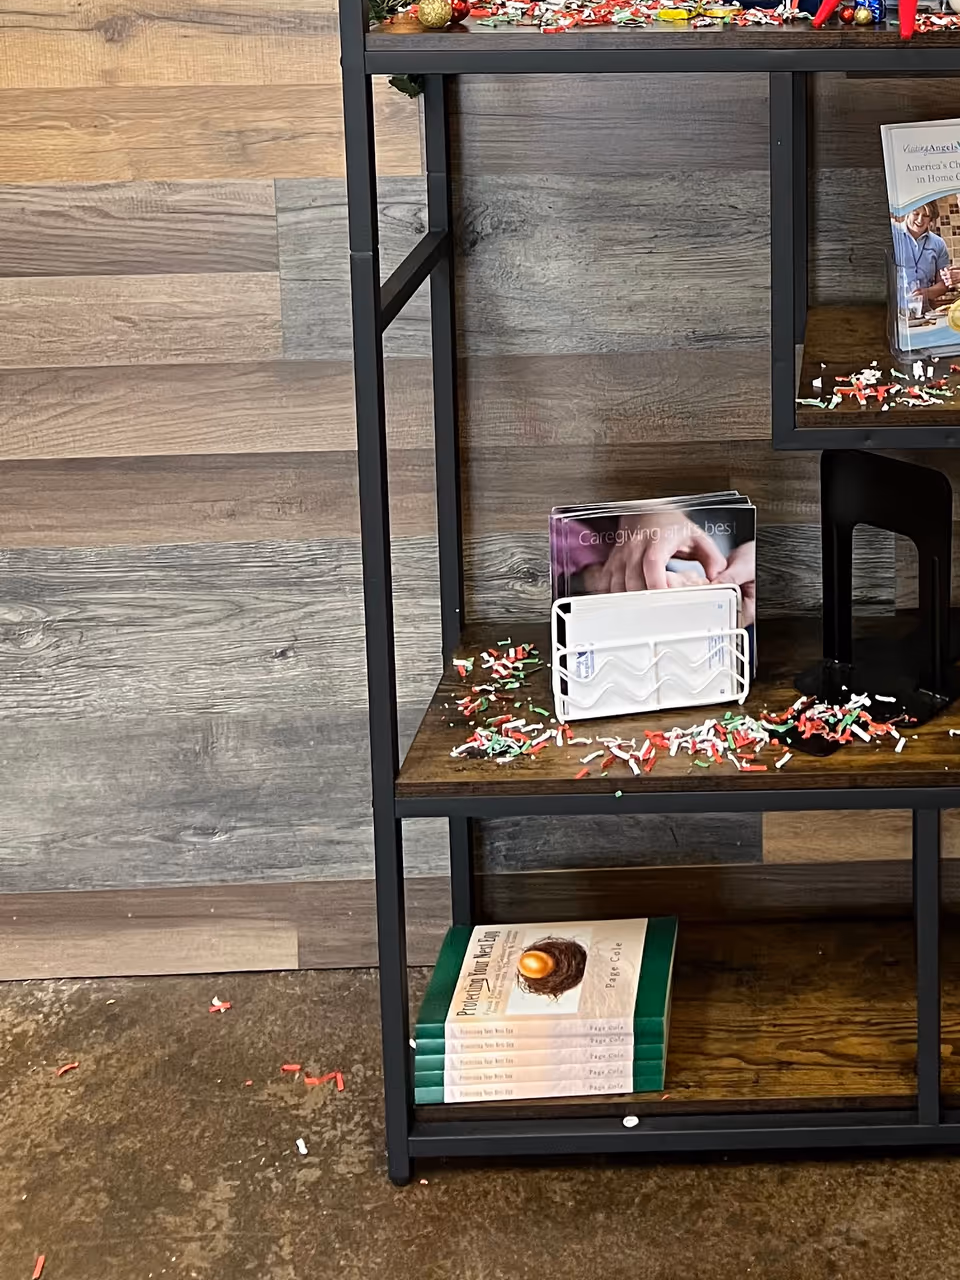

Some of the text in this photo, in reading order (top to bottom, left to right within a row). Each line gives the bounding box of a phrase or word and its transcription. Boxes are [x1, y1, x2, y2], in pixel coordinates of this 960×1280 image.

[905, 160, 948, 172] America's
[916, 176, 926, 184] in
[927, 173, 954, 184] Home
[578, 526, 661, 546] Caregiving
[703, 520, 737, 535] best
[472, 942, 496, 960] Nest
[467, 960, 491, 978] Your
[605, 942, 623, 989] Page Cole
[456, 977, 491, 1017] Protecting
